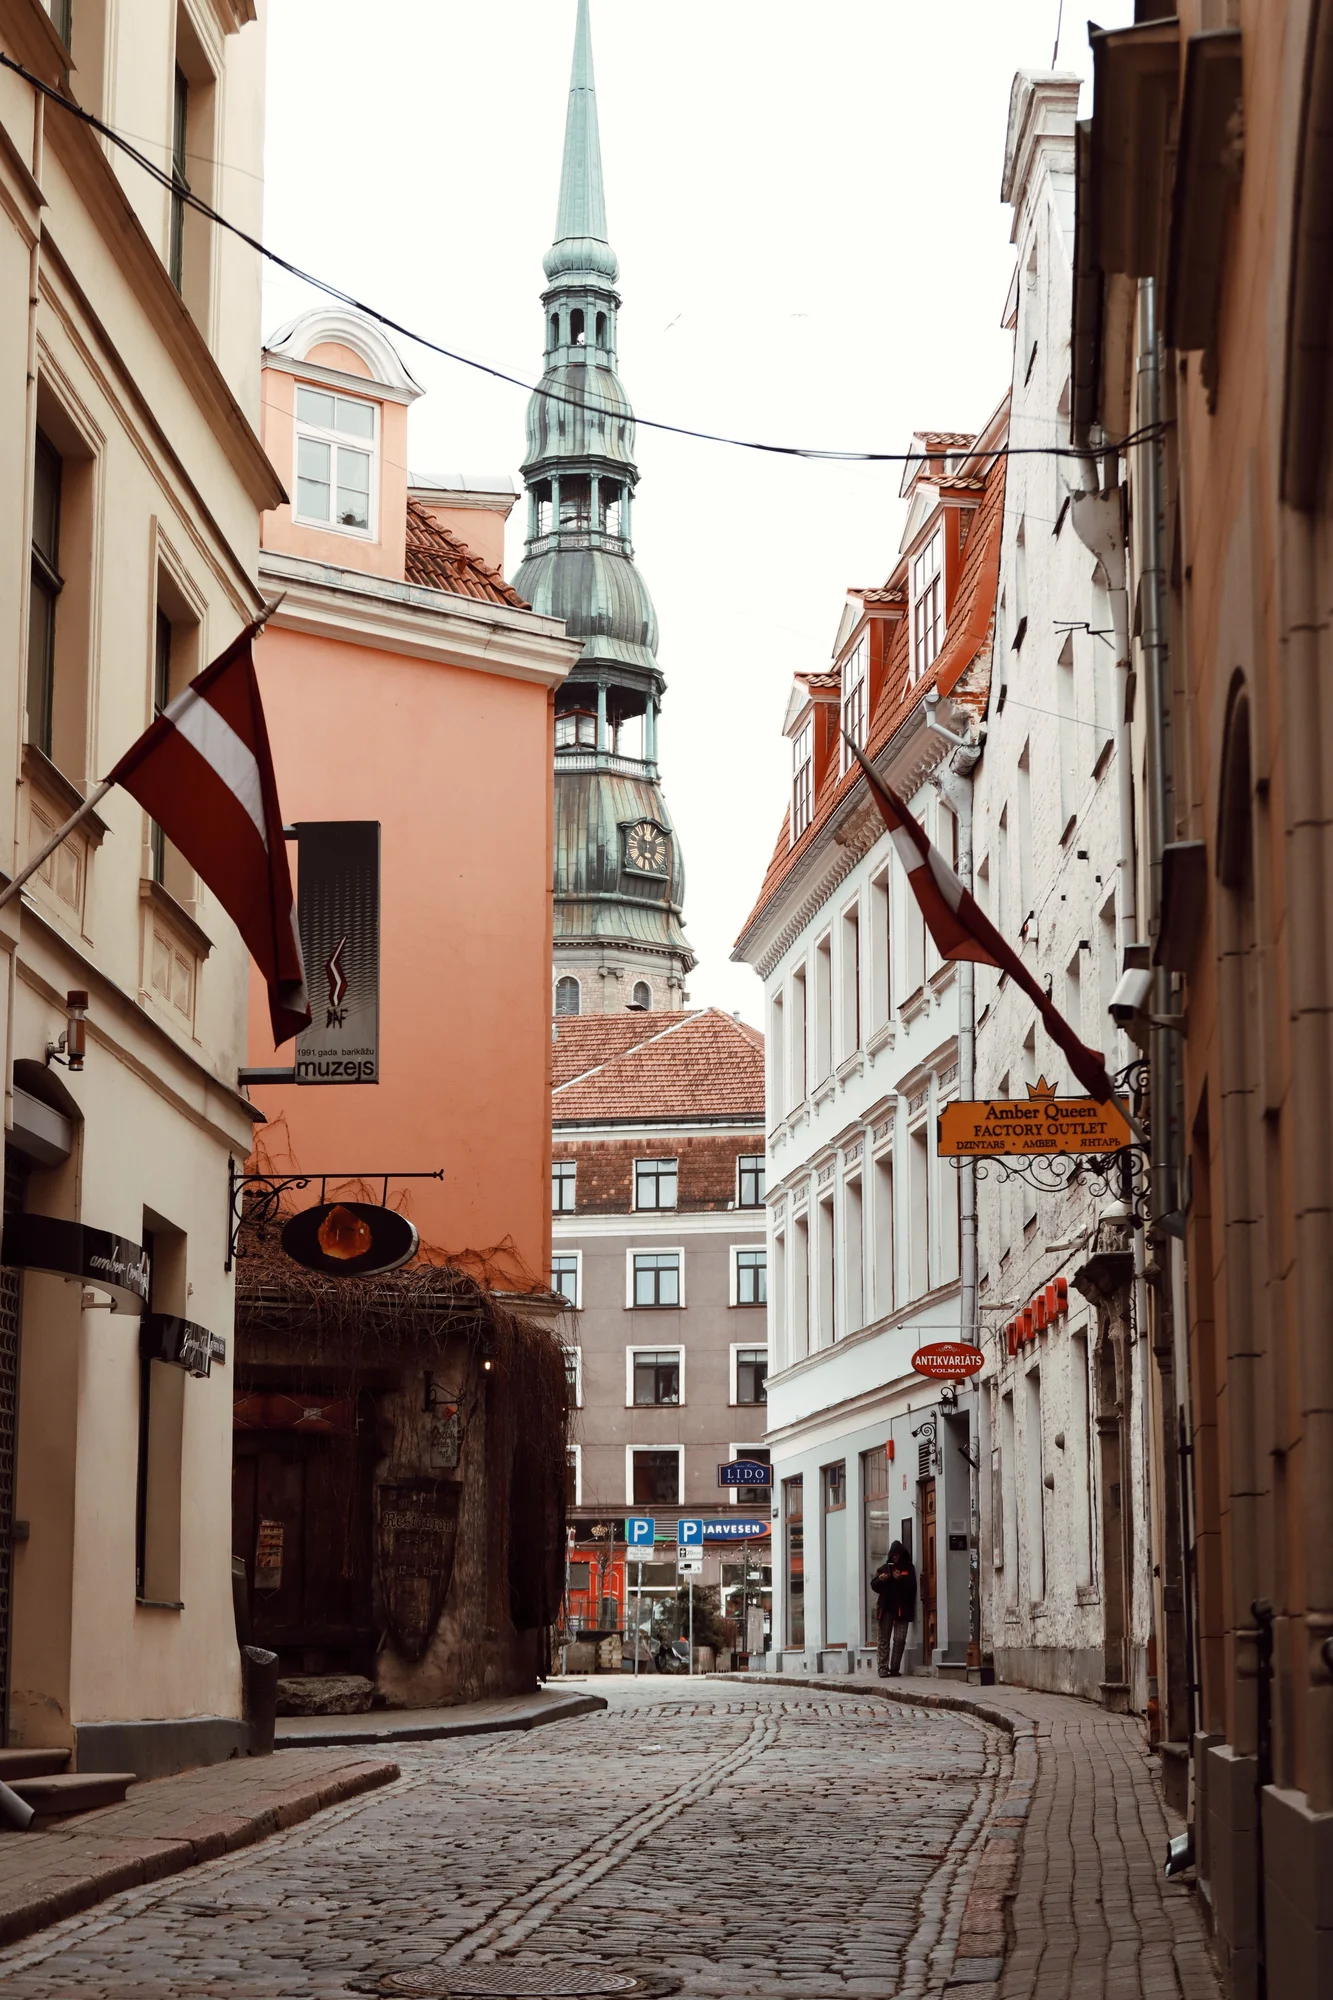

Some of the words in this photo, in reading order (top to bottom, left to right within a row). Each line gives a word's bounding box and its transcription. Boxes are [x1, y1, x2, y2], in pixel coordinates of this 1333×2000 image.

[318, 1049, 337, 1057] gada
[297, 1060, 374, 1080] muzejs
[985, 1104, 1040, 1120] Amber
[1044, 1103, 1098, 1122] Queen
[974, 1124, 1043, 1137] FACTORY
[1047, 1121, 1108, 1135] OUTLET
[956, 1140, 1005, 1150] DZINTARS
[1022, 1139, 1057, 1148] AMBER
[1080, 1138, 1121, 1147] ЯНТАРЬ
[89, 1246, 126, 1274] amber
[915, 1353, 982, 1366] ANTIKVARIĀTS
[727, 1469, 764, 1479] LIDO
[633, 1521, 649, 1542] P
[683, 1522, 697, 1542] P
